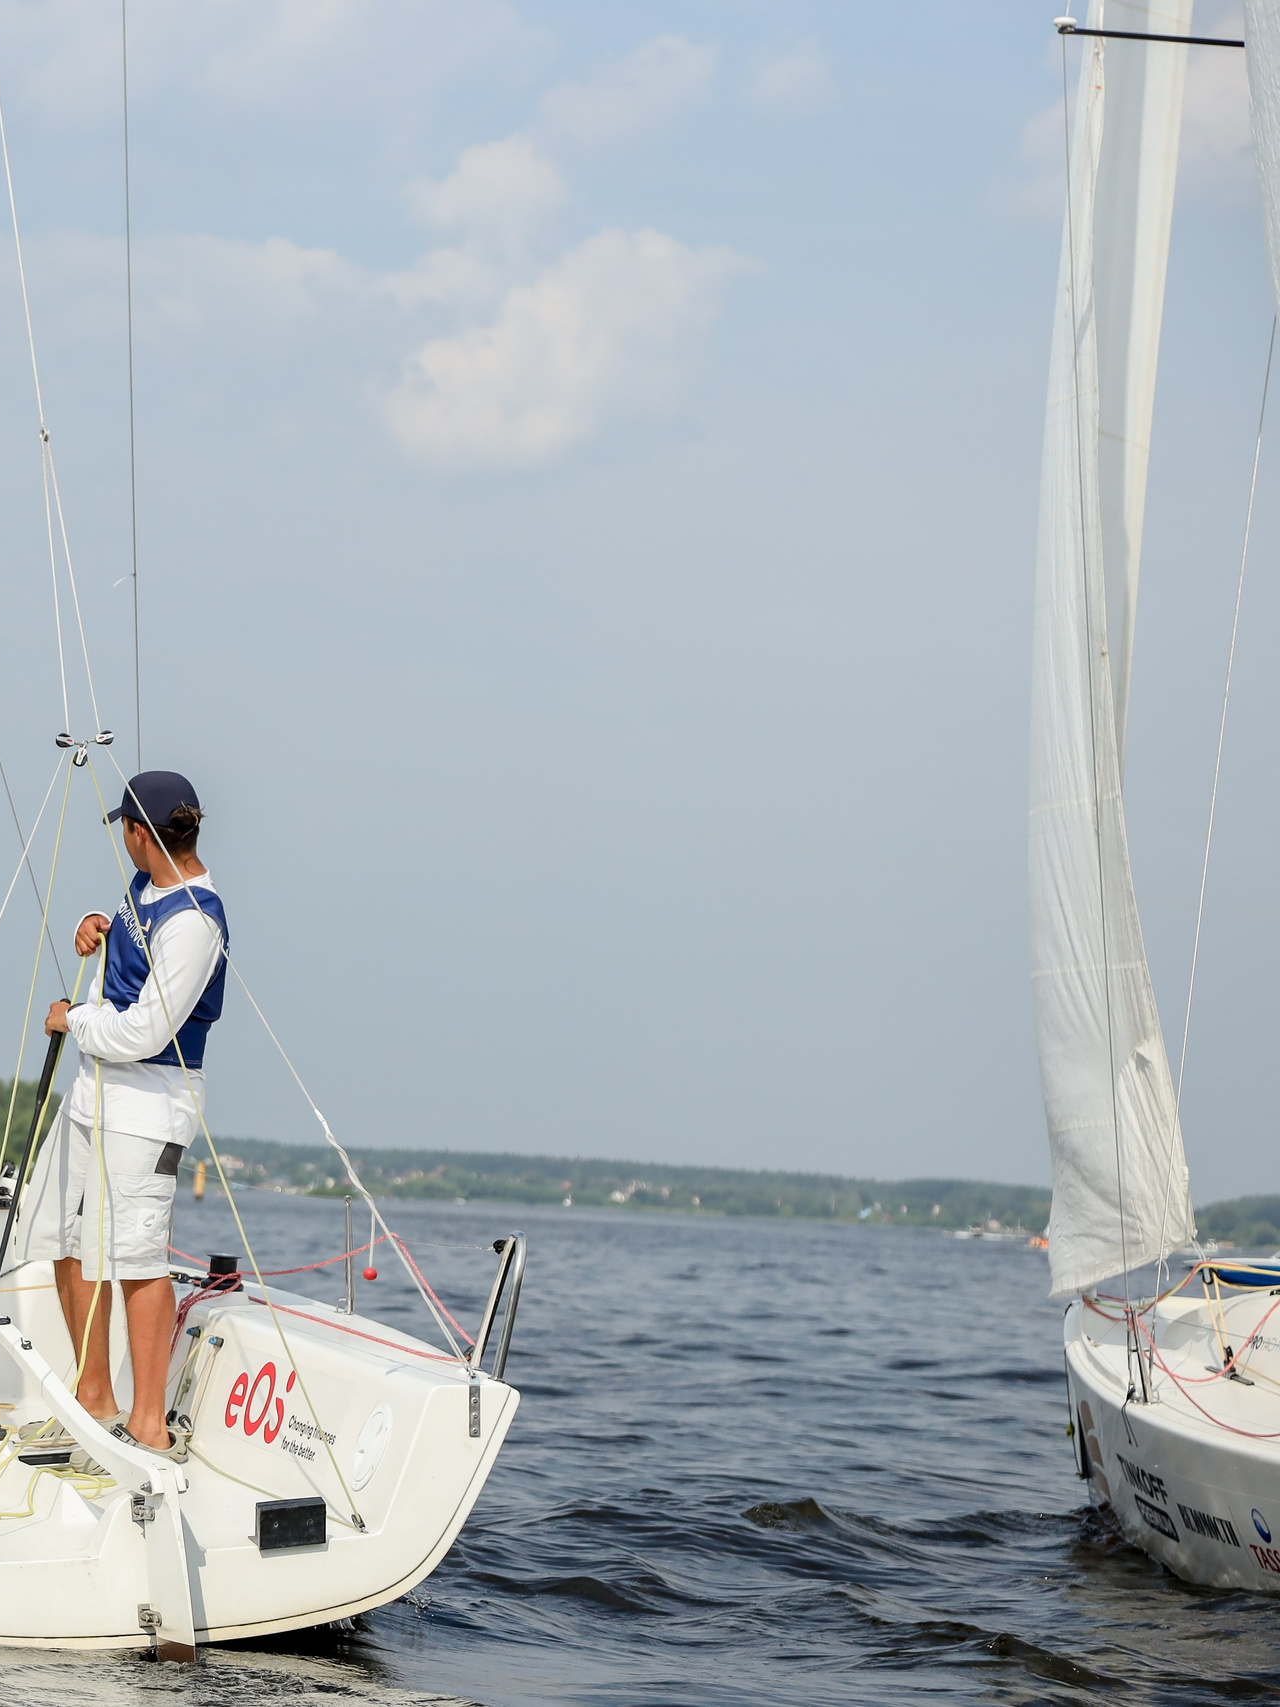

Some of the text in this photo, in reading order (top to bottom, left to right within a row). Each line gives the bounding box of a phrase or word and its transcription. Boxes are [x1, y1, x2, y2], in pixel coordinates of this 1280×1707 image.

[288, 1415, 314, 1439] Changing
[281, 1436, 316, 1461] for the better.
